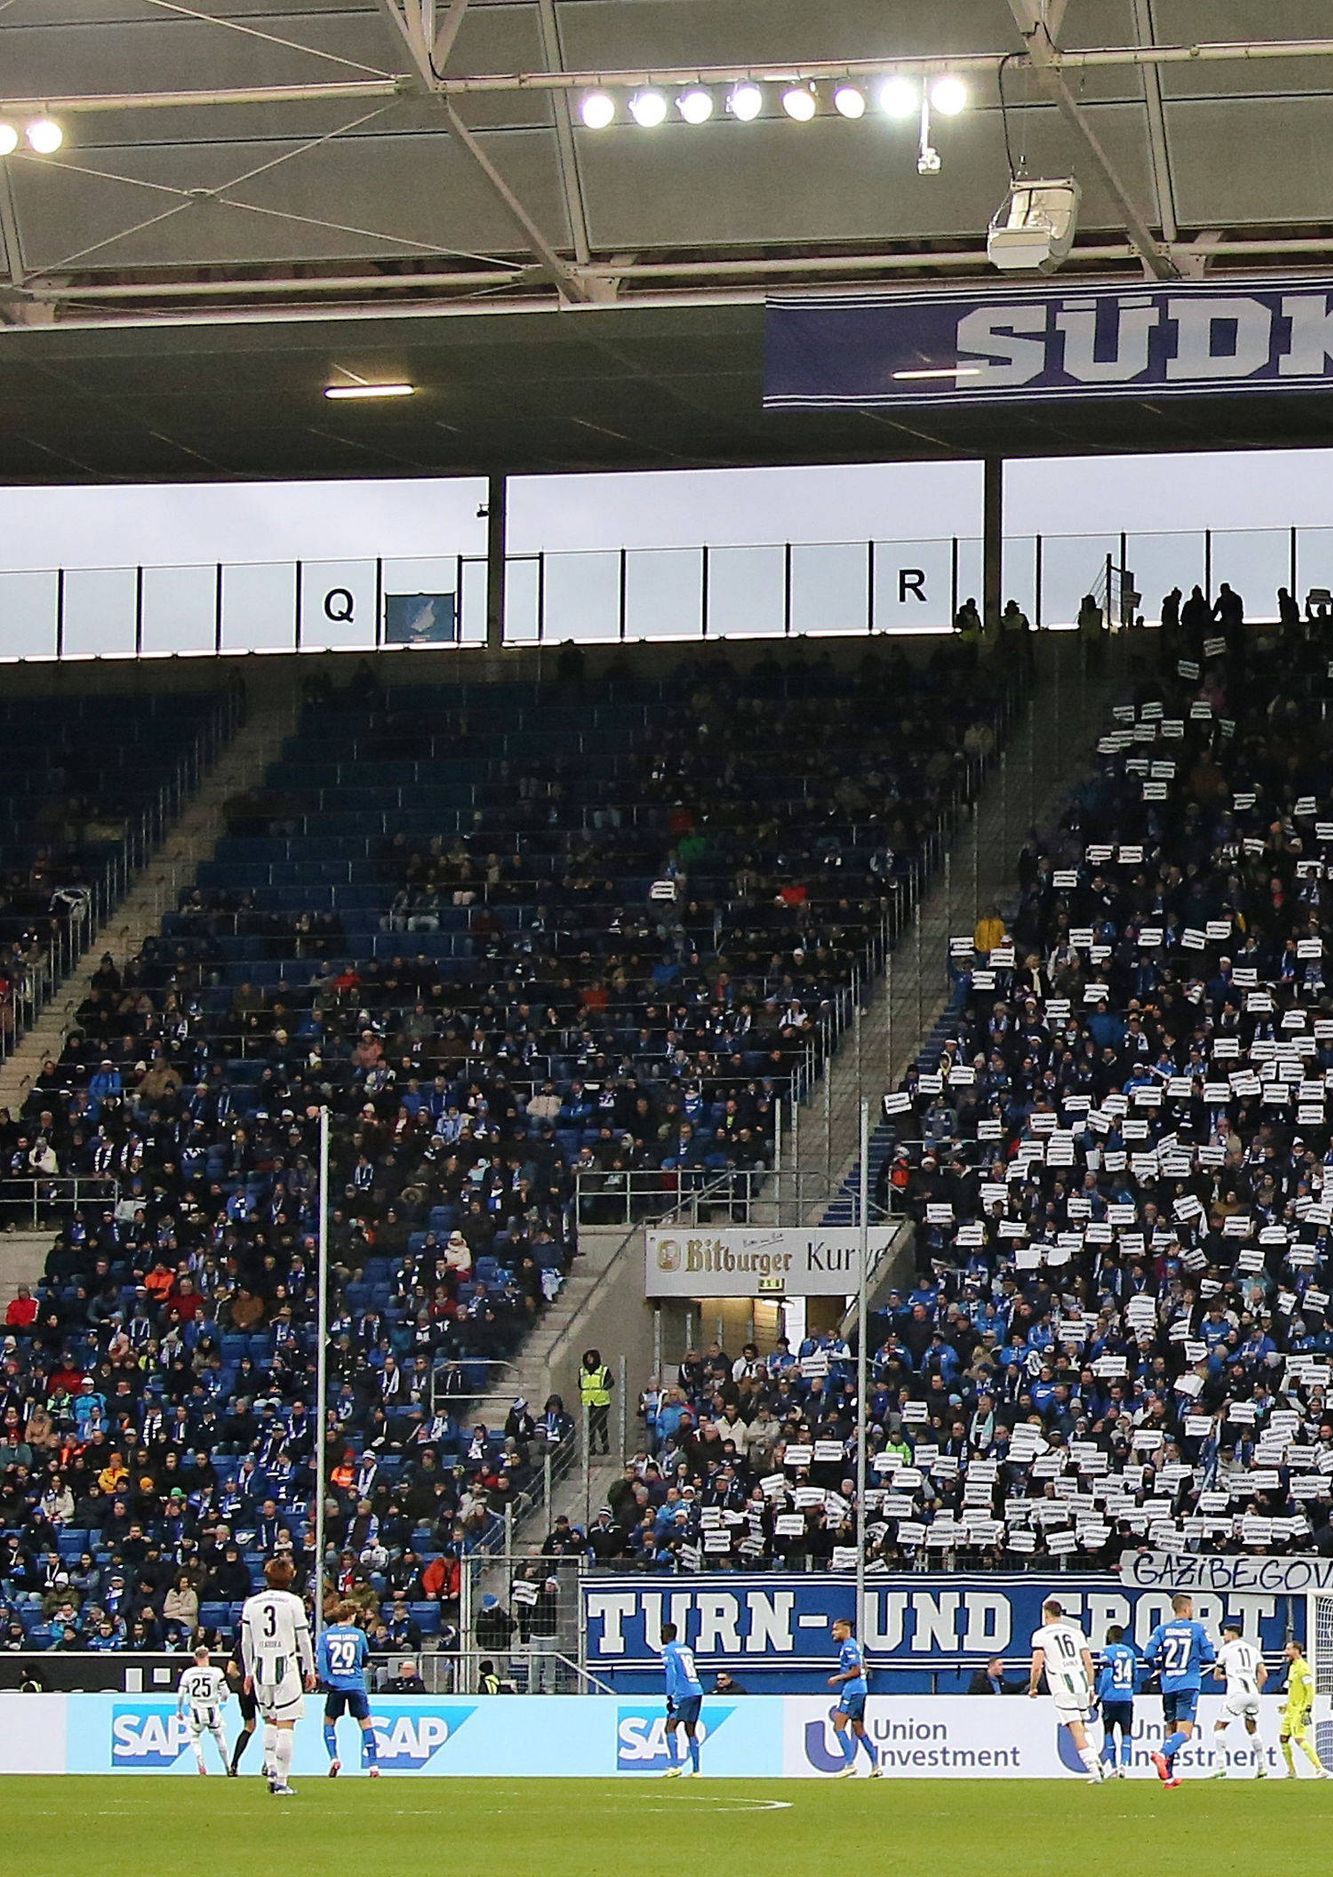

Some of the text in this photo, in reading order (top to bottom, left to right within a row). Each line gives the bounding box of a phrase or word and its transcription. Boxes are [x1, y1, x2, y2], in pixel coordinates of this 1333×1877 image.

[898, 566, 928, 604] R
[323, 587, 355, 626] Q
[684, 1237, 793, 1276] Bitburger
[264, 1605, 276, 1638] 3
[588, 1590, 828, 1654] TURN-
[864, 1591, 1012, 1652] UND
[329, 1641, 356, 1668] 29
[1054, 1633, 1076, 1659] 16
[1163, 1638, 1193, 1669] 27
[1238, 1647, 1252, 1668] 11
[1113, 1658, 1133, 1682] 34
[192, 1677, 211, 1698] 25
[112, 1714, 192, 1757] SAP
[874, 1717, 947, 1741] Union
[875, 1745, 1020, 1769] Investment
